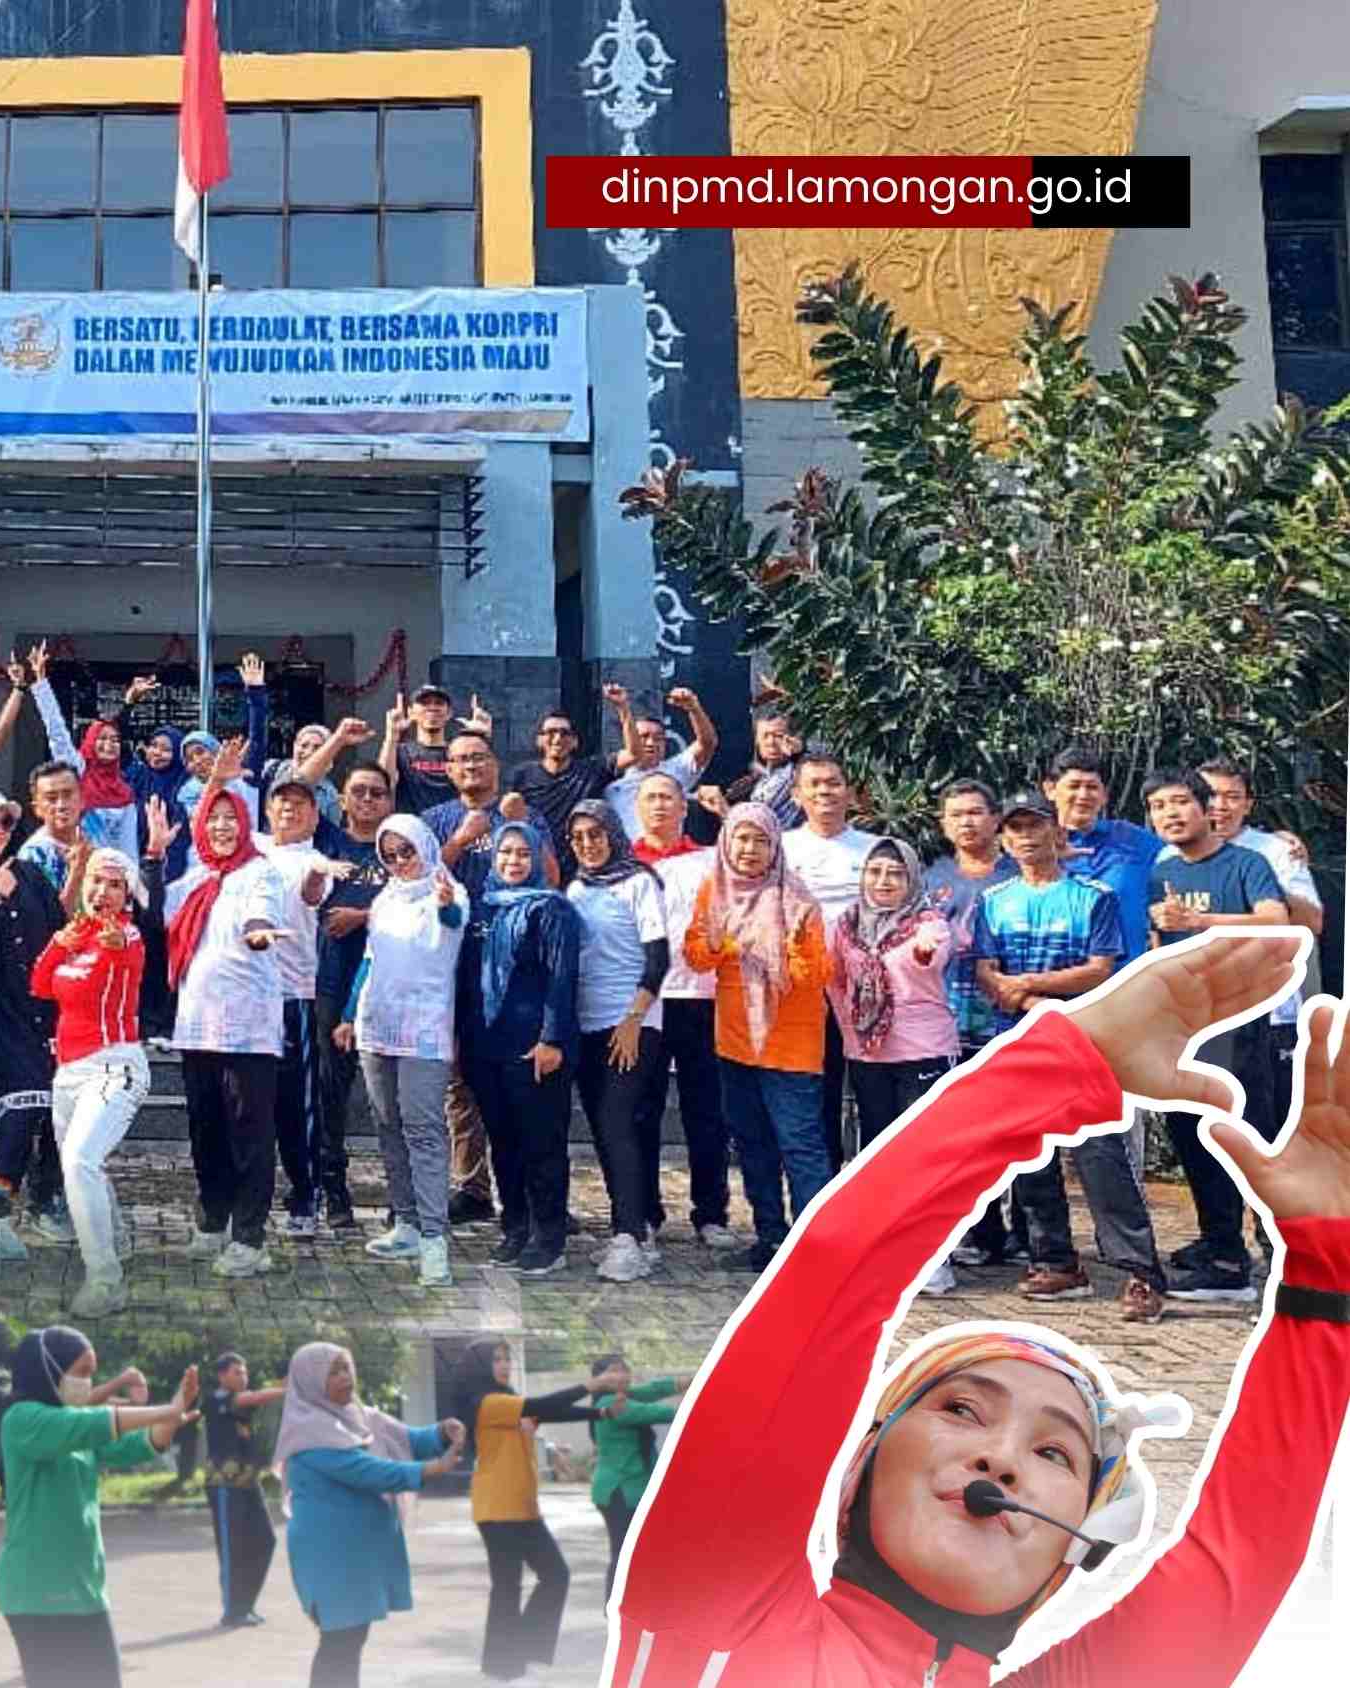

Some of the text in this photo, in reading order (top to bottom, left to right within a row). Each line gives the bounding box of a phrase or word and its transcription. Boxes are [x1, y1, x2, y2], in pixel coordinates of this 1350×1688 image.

[74, 316, 188, 344] BERSATU,
[340, 313, 461, 342] BERSAMA
[465, 311, 559, 338] KORPRI
[74, 348, 155, 374] DALAM
[342, 345, 477, 373] INDONESIA
[482, 344, 551, 371] MAJU
